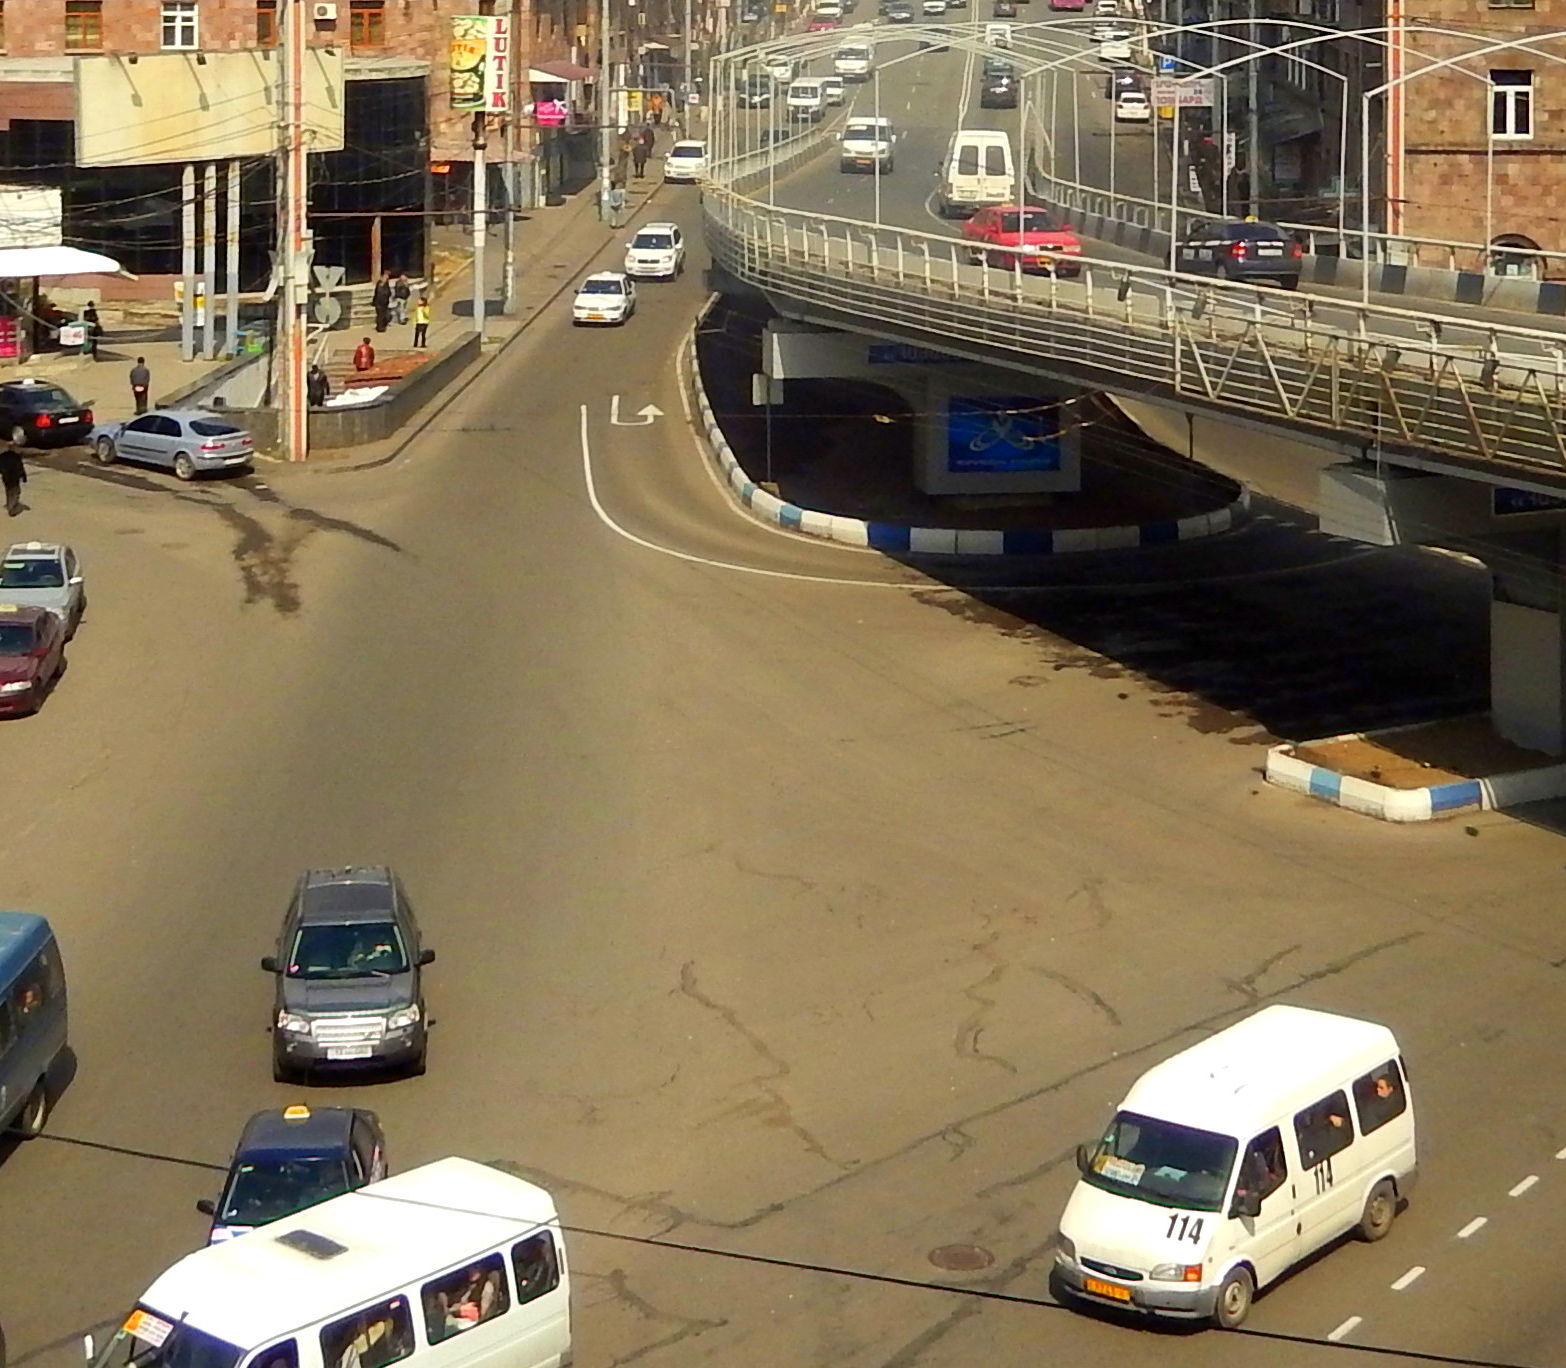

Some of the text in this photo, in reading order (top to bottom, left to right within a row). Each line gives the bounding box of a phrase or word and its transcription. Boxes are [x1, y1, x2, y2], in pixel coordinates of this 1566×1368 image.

[491, 18, 508, 108] LUTIK
[1314, 1156, 1334, 1196] 114
[1166, 1212, 1205, 1245] 114
